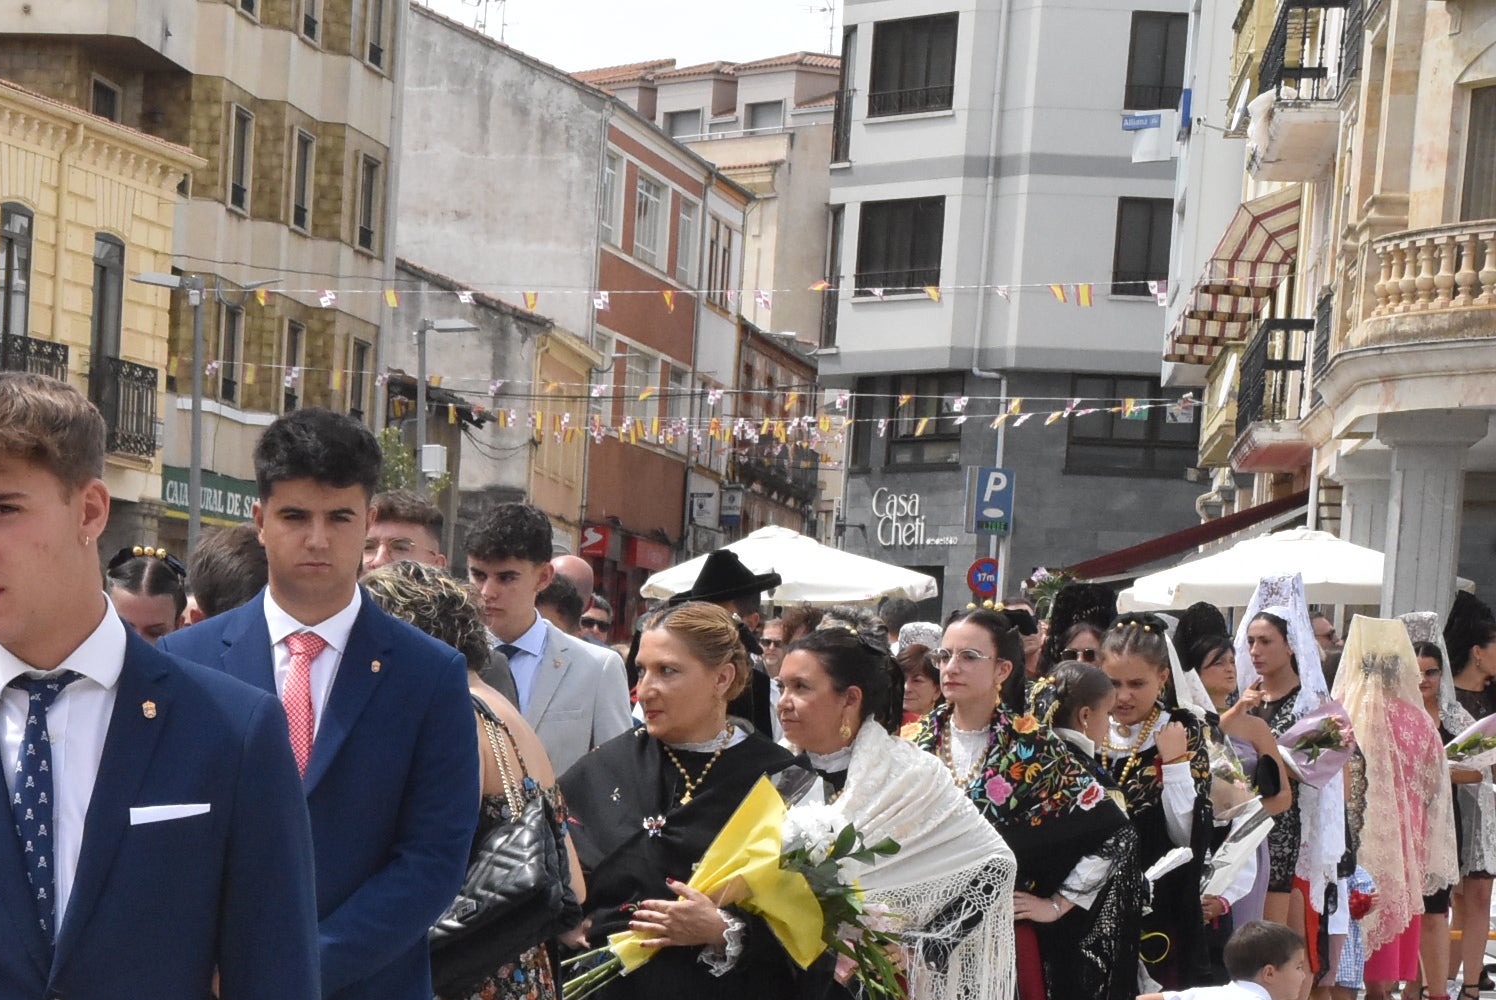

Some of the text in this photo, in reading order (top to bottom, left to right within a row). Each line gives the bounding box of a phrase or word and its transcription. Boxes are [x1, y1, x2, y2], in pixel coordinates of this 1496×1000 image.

[1124, 117, 1148, 126] Allianz
[166, 480, 189, 507] CAJA
[200, 486, 224, 513] URAL
[226, 492, 242, 515] DE
[983, 471, 1008, 502] P
[872, 487, 920, 517] Casa
[877, 515, 926, 546] Cheti
[977, 573, 995, 582] 17m
